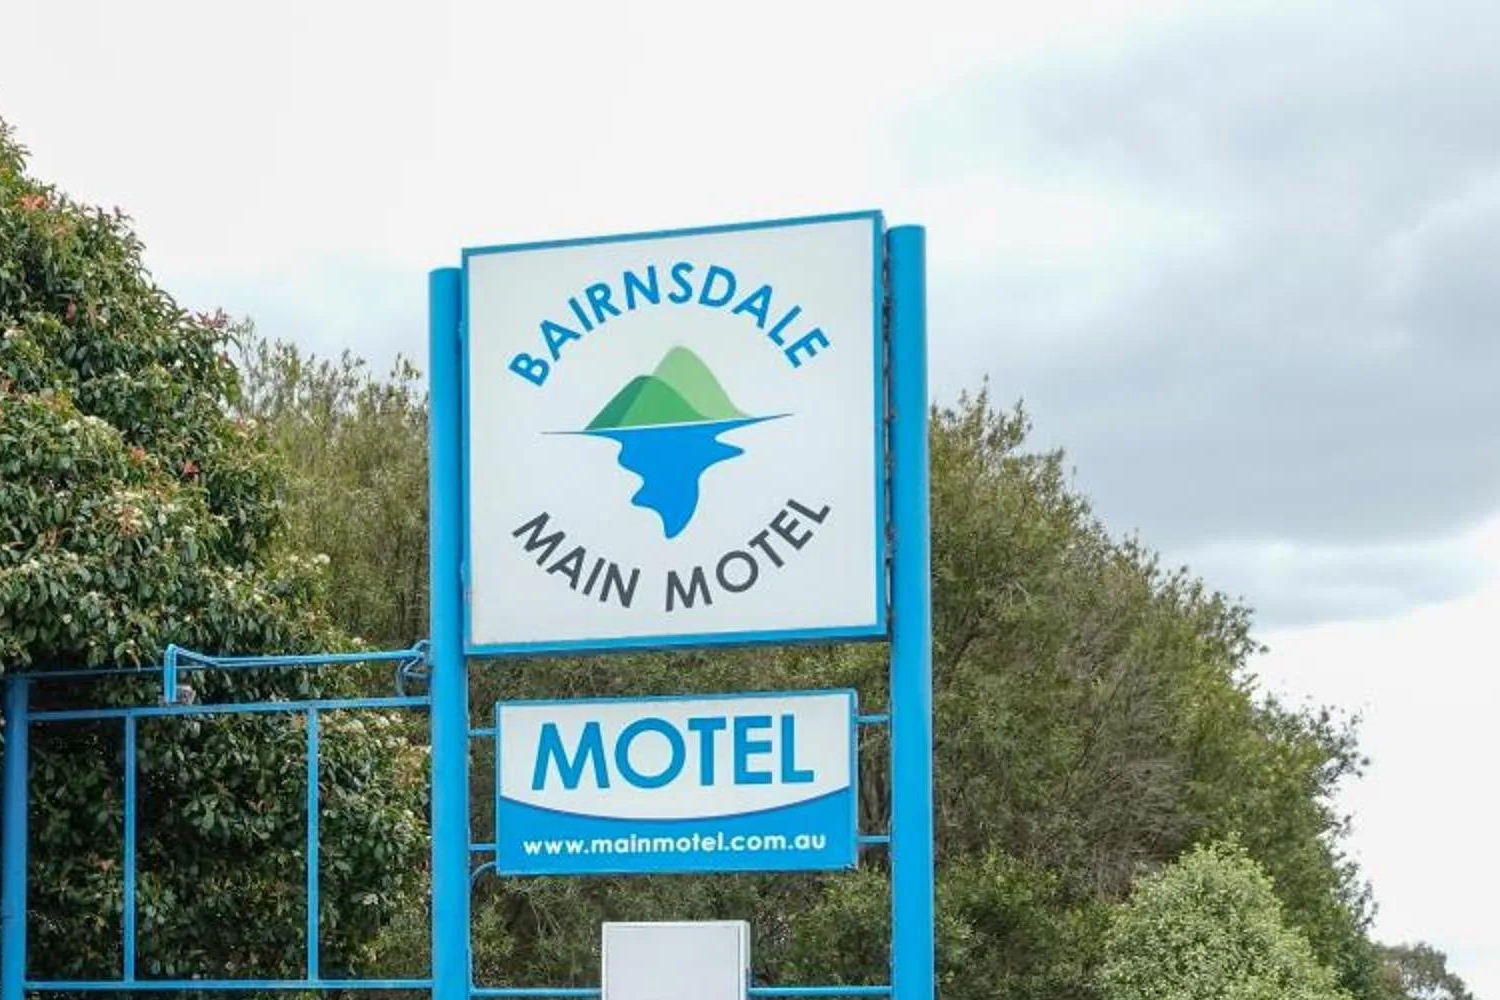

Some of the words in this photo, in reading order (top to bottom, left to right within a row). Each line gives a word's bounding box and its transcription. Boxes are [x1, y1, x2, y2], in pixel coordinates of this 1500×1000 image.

[508, 261, 831, 387] BAIRNSDALE
[512, 511, 641, 608] MAIN
[665, 498, 832, 612] MOTEL
[531, 714, 815, 791] MOTEL
[522, 831, 827, 856] www.mainmotel.com.au
